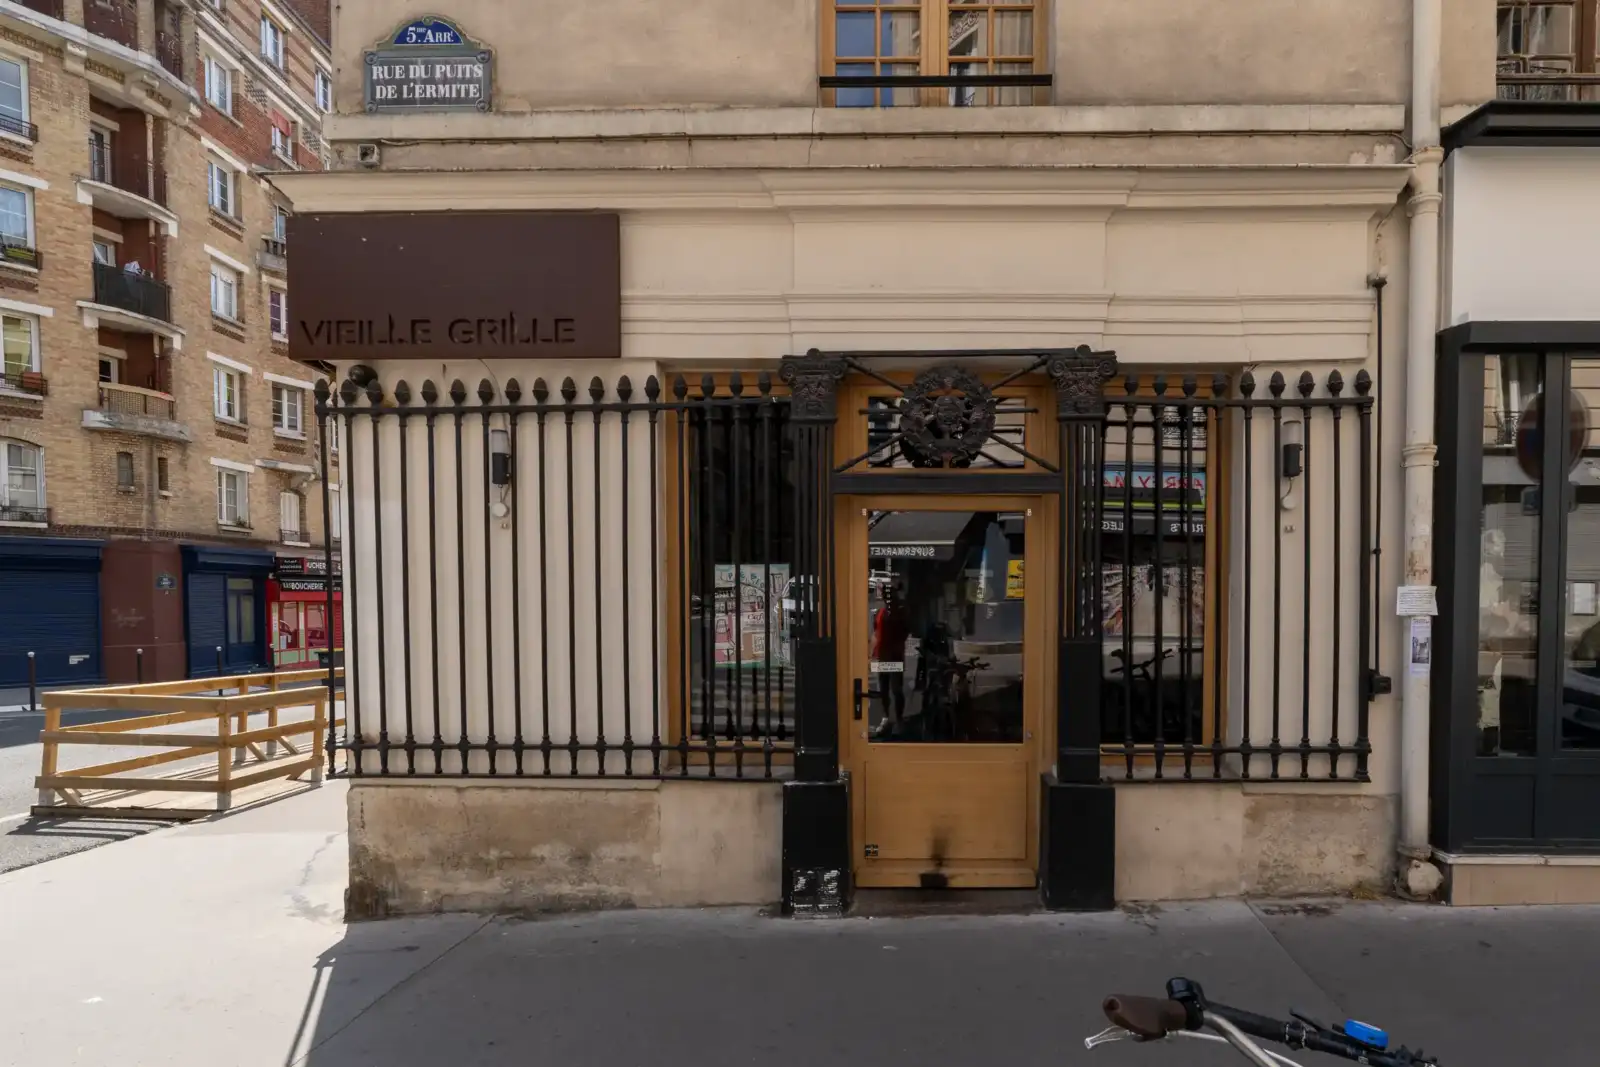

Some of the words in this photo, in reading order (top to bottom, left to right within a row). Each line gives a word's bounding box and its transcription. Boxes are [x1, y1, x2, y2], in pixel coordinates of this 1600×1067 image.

[372, 65, 405, 80] RUE
[409, 65, 431, 79] DU
[435, 64, 483, 79] PUITS
[375, 85, 397, 99] DE
[402, 82, 480, 98] L'ERMITE
[300, 316, 432, 346] VIEILLE
[448, 315, 575, 344] GRILLE
[747, 612, 765, 621] Caf
